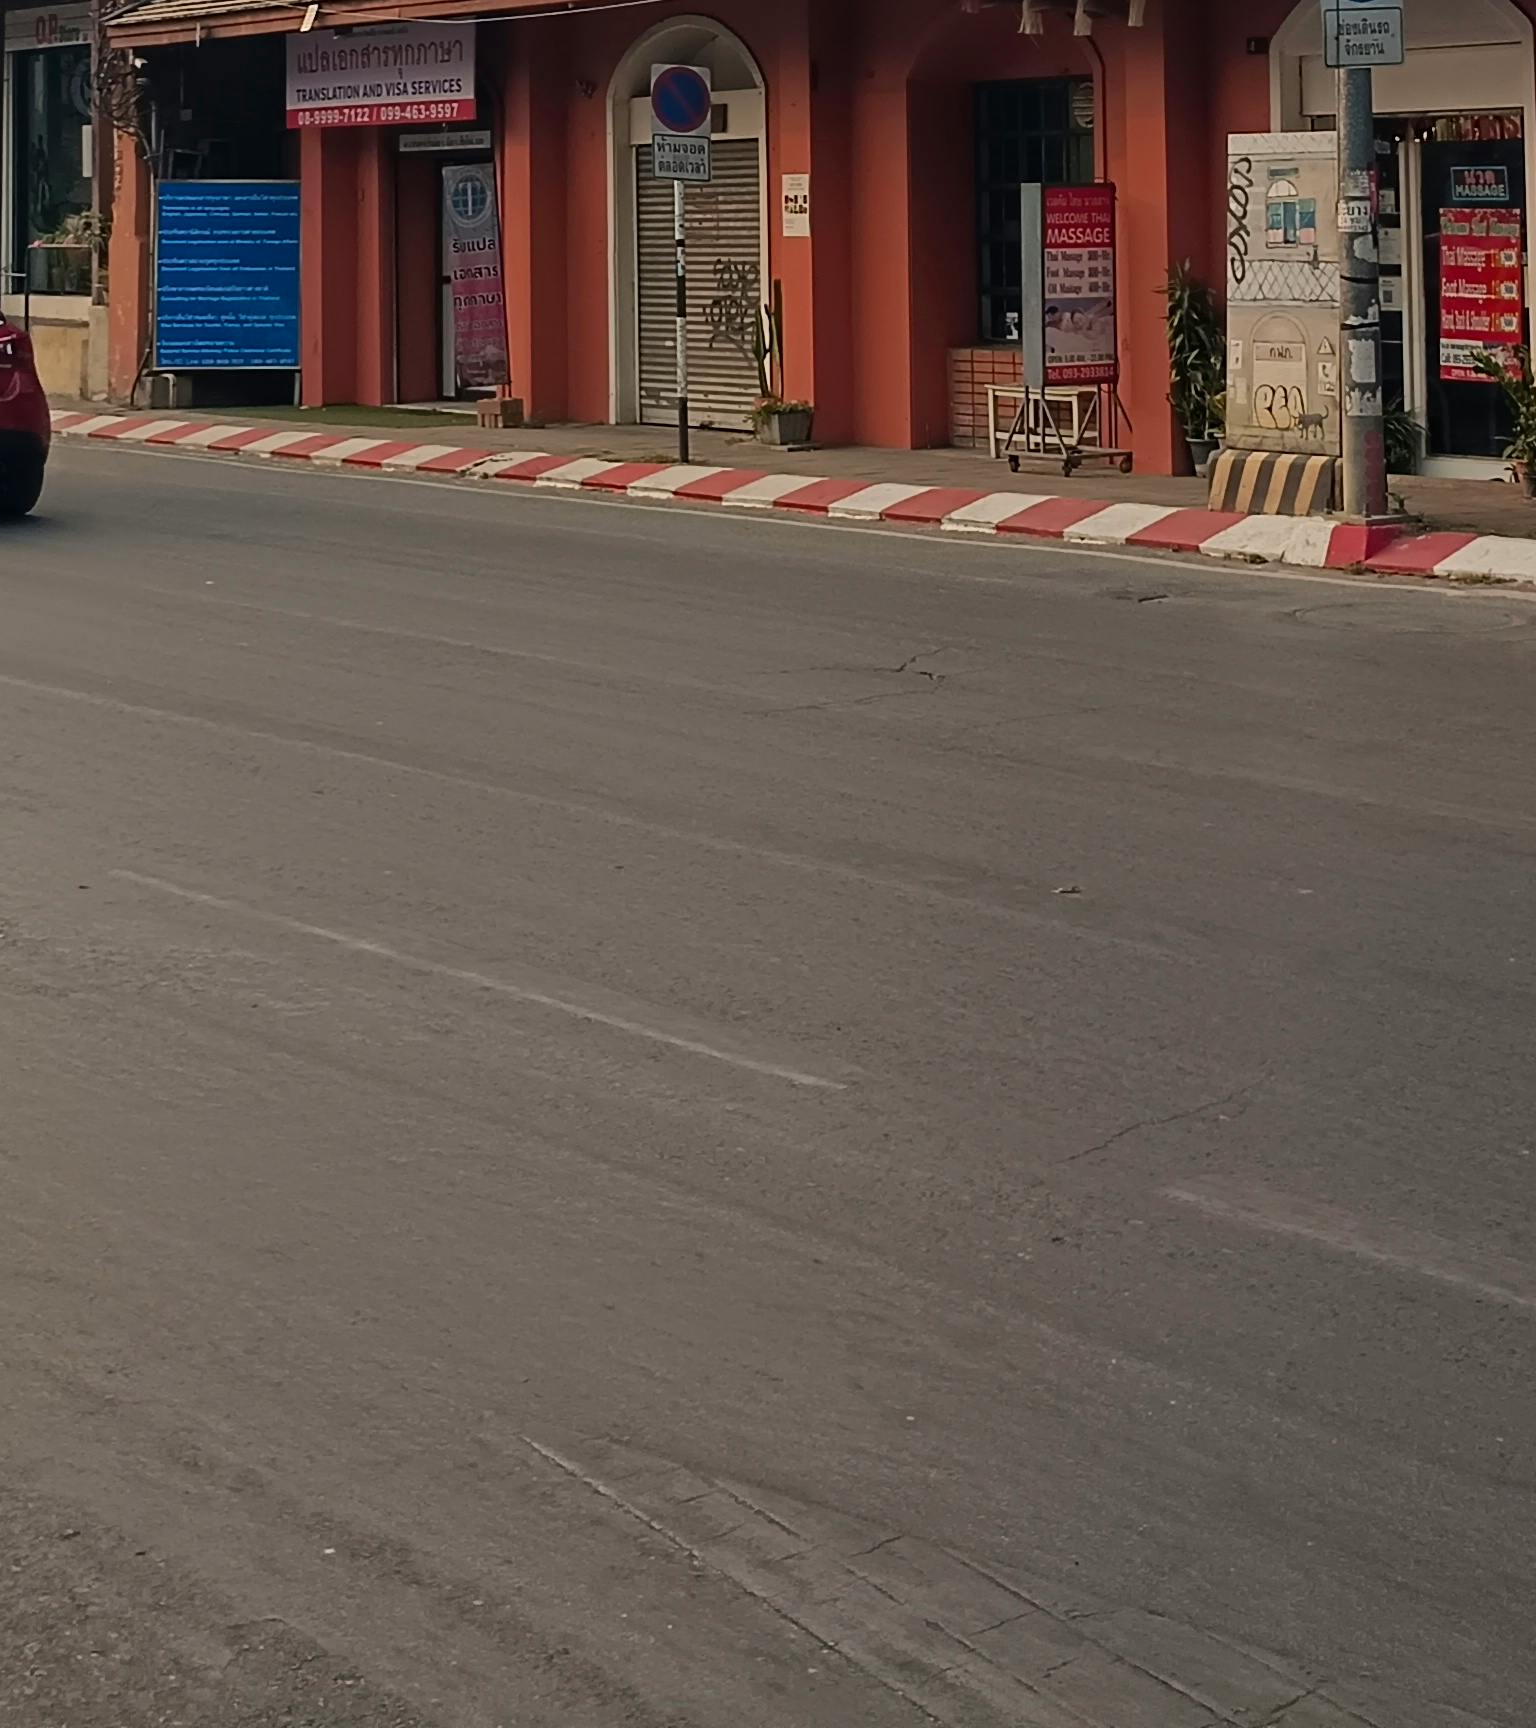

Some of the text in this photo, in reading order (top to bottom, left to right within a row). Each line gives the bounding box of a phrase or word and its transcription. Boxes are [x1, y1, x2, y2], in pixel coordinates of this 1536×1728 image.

[297, 38, 464, 80] แปลเอกสารทุกภาษา
[296, 78, 463, 103] TRANSLATION AND VISA SERVICES
[380, 102, 459, 121] 099-463-9597
[656, 135, 706, 156] ห้ามจอด
[1455, 184, 1506, 198] MASSAGE
[1046, 212, 1111, 224] WELCOME THAI
[1046, 227, 1111, 244] MASSAGE
[452, 263, 499, 281] เอกสาร
[1254, 384, 1306, 430] PEA
